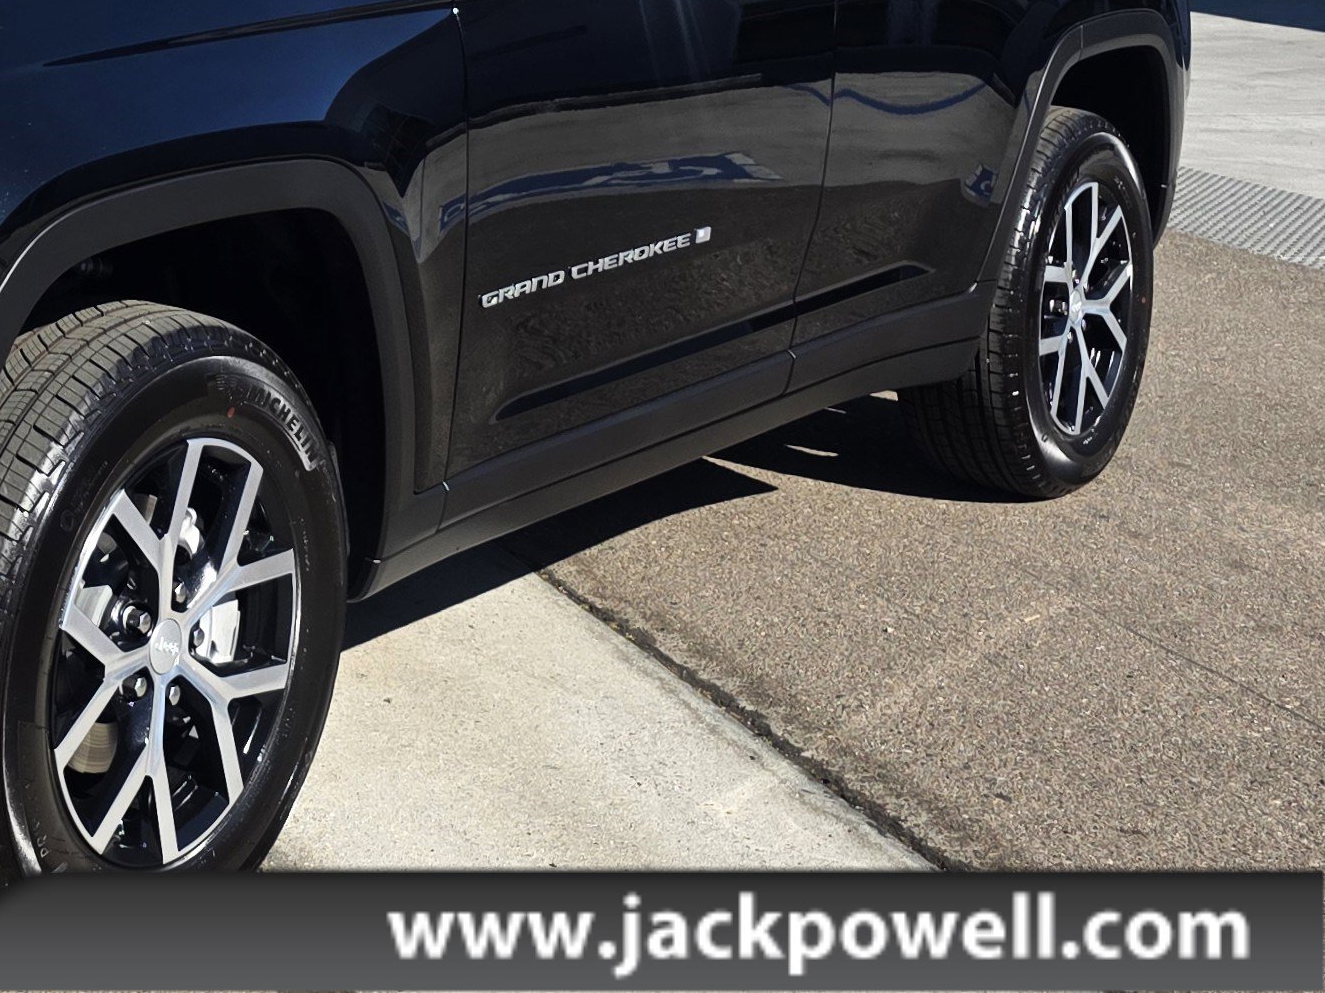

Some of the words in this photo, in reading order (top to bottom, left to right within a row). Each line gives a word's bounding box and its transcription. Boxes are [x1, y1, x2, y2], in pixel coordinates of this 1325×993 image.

[480, 269, 566, 308] GRAND
[570, 231, 692, 281] CHEROKEE
[247, 384, 318, 466] MICHELIN
